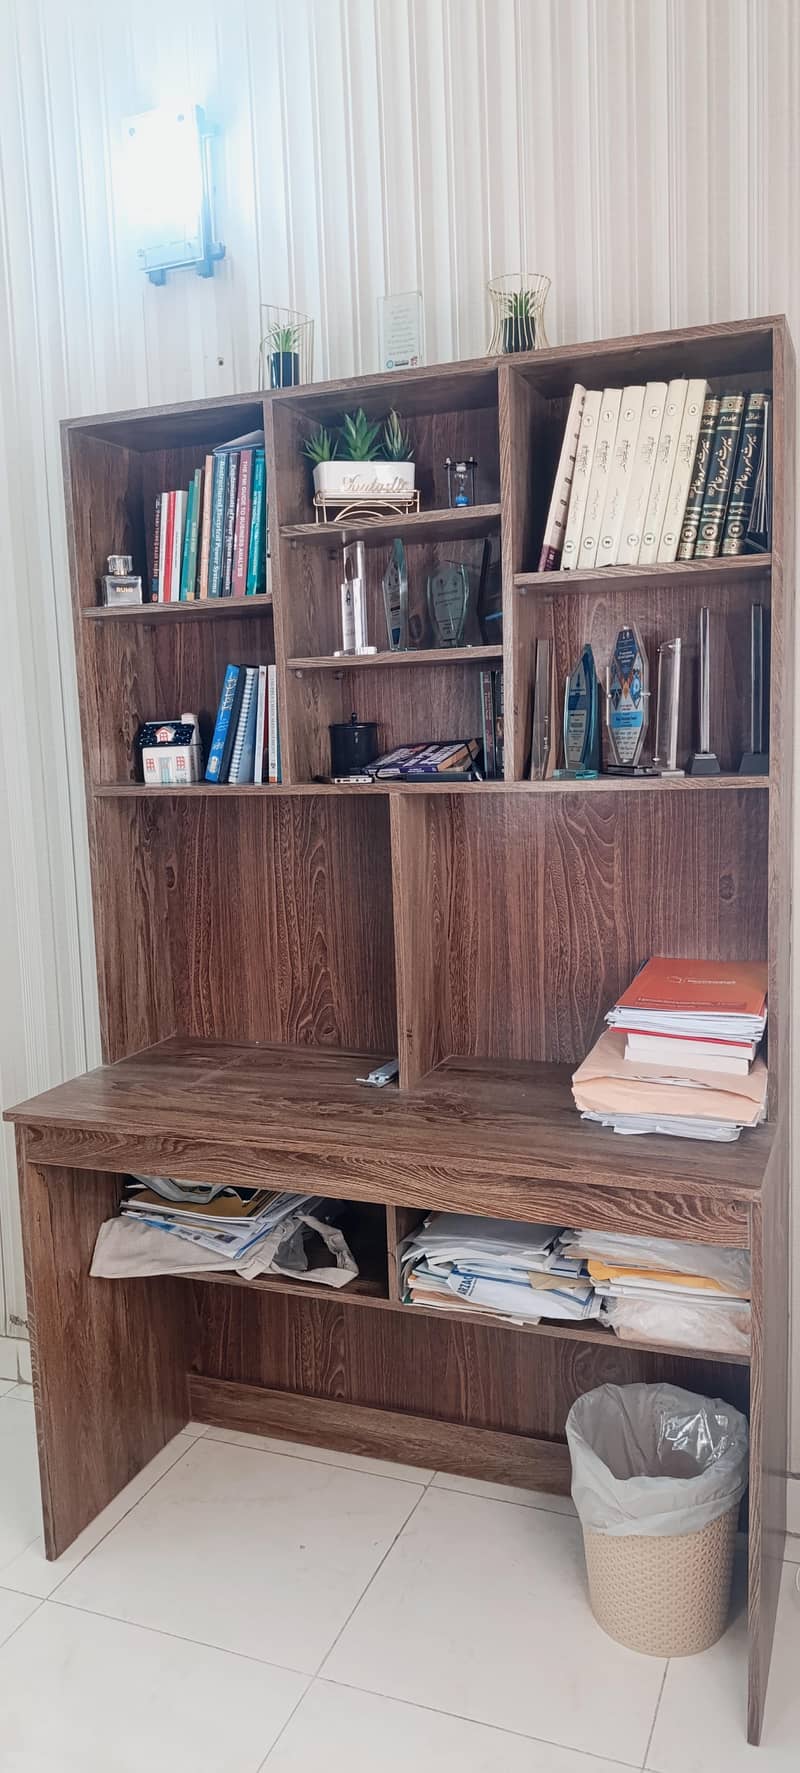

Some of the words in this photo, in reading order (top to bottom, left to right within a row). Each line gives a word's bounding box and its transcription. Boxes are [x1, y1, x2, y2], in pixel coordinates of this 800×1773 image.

[229, 464, 237, 508] Fundamentals
[215, 510, 223, 541] Electrical
[240, 507, 246, 515] TO
